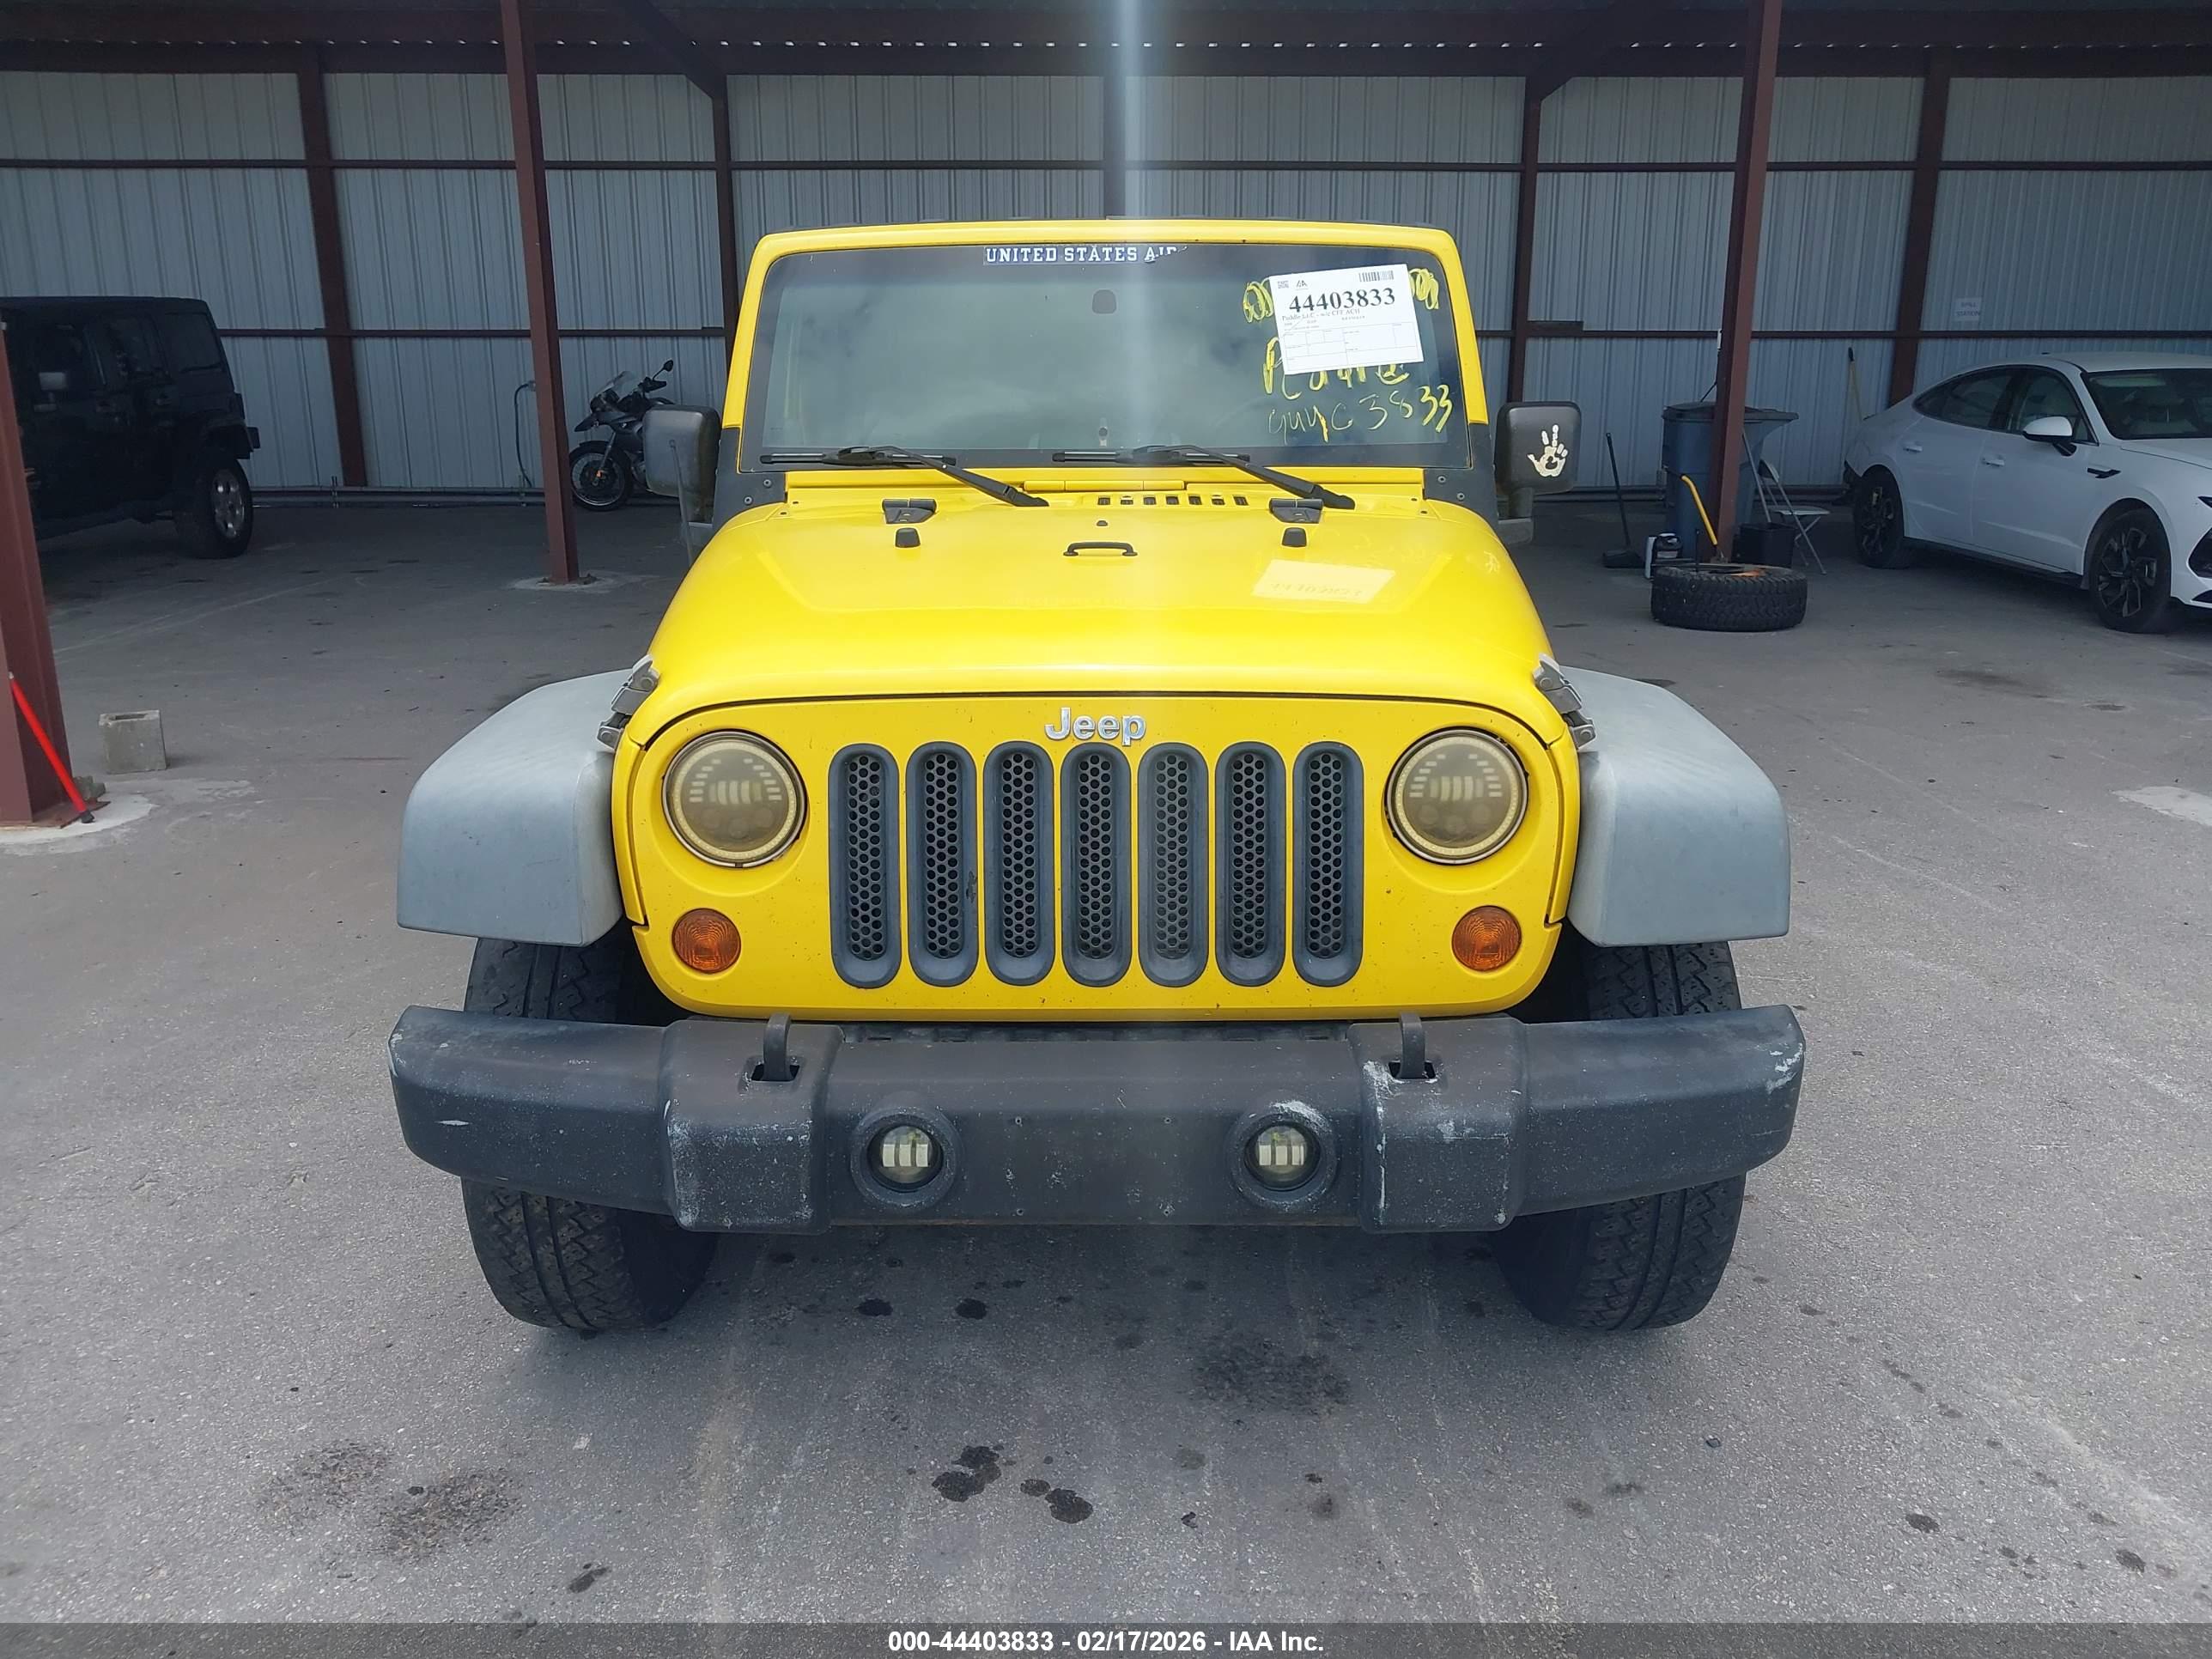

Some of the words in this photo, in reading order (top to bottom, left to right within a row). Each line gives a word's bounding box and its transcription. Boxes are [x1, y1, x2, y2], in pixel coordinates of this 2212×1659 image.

[987, 247, 1057, 262] UNITED
[1064, 246, 1138, 262] STATES
[1288, 287, 1395, 313] 44403833
[1044, 707, 1146, 746] Jeep
